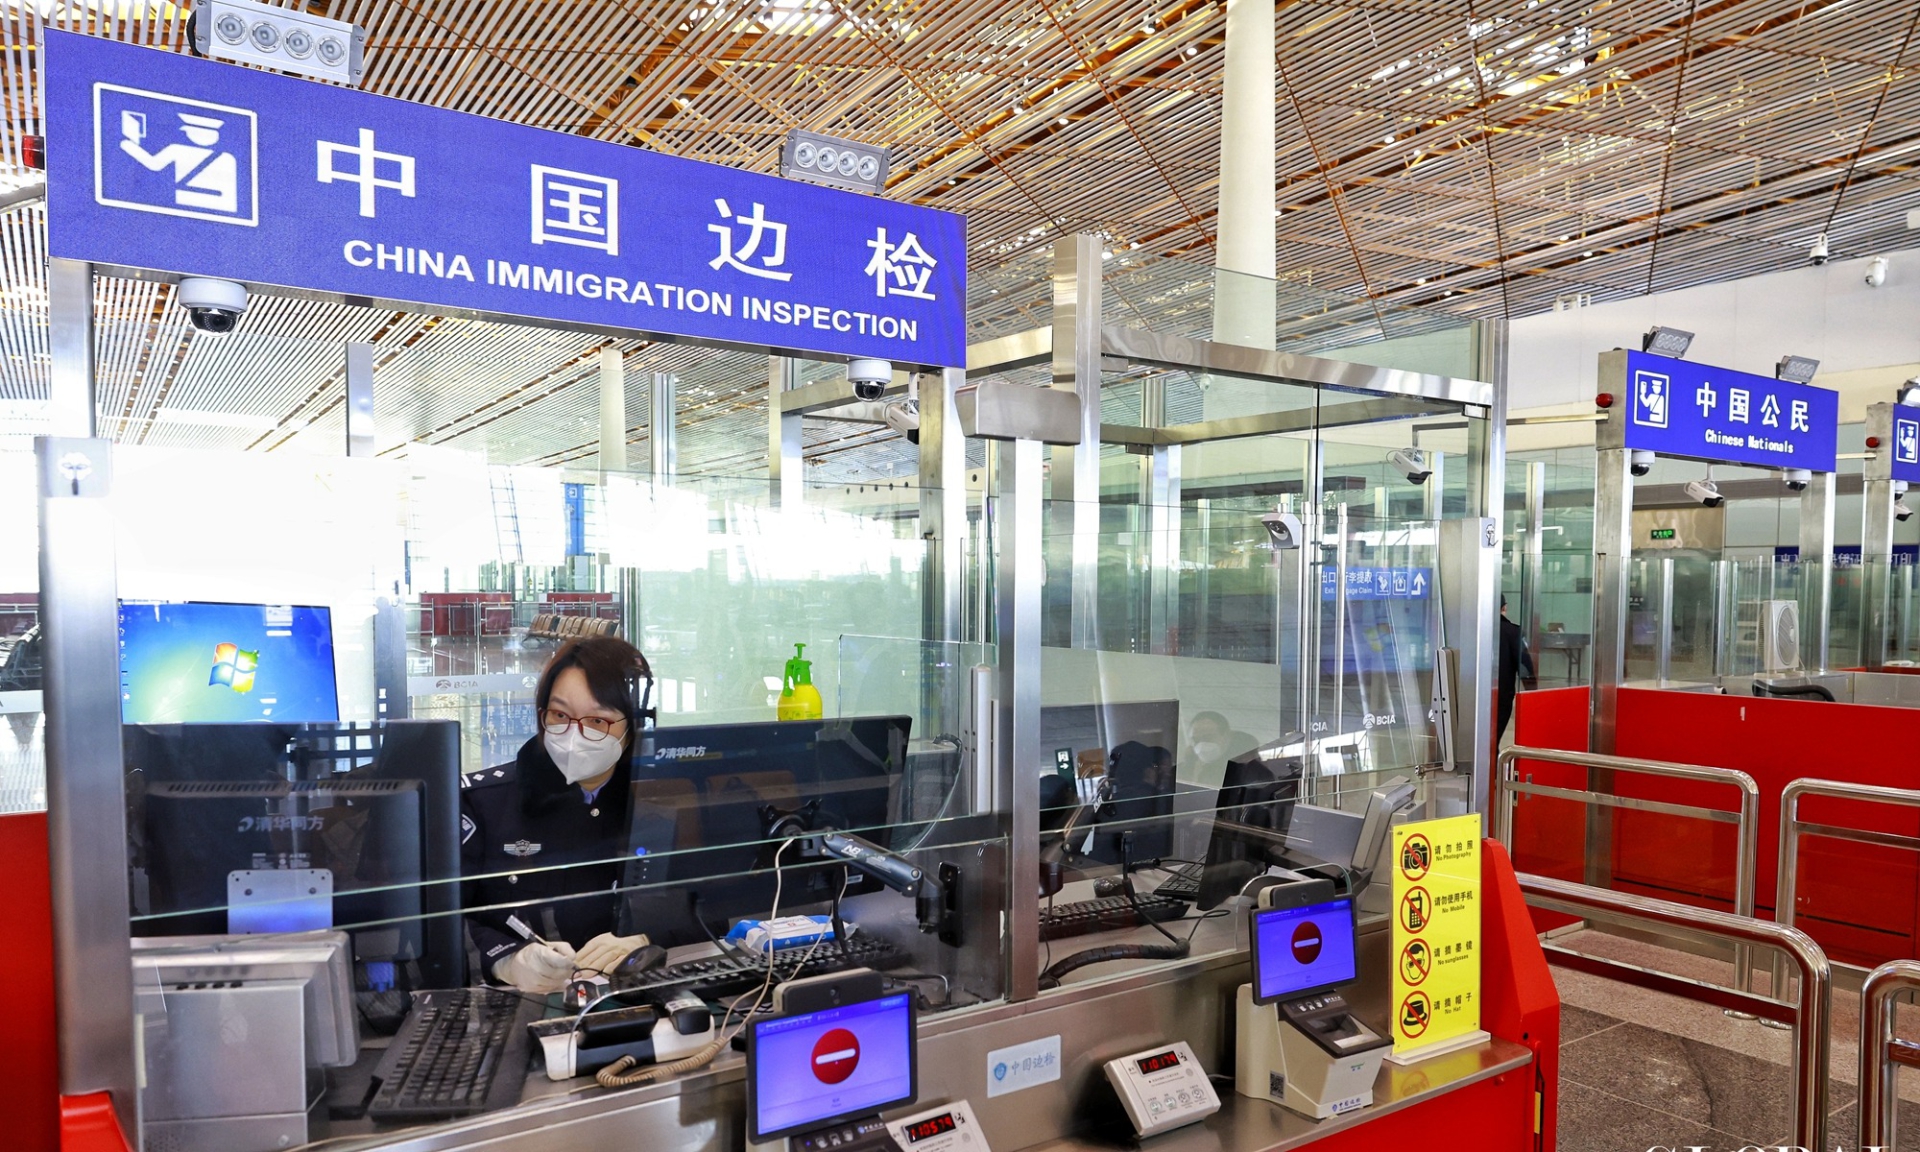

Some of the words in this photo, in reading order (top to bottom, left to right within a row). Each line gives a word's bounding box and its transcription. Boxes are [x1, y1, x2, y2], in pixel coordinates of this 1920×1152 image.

[317, 128, 937, 302] 中国边检
[342, 239, 475, 283] CHINA
[486, 259, 733, 317] IMMIGRATION
[741, 297, 919, 341] INSPECTION
[1696, 381, 1810, 433] 中国公民
[1705, 428, 1744, 447] Chinese
[1748, 435, 1795, 454] Nationals
[1310, 721, 1328, 732] CIA
[1376, 714, 1397, 726] BCIA
